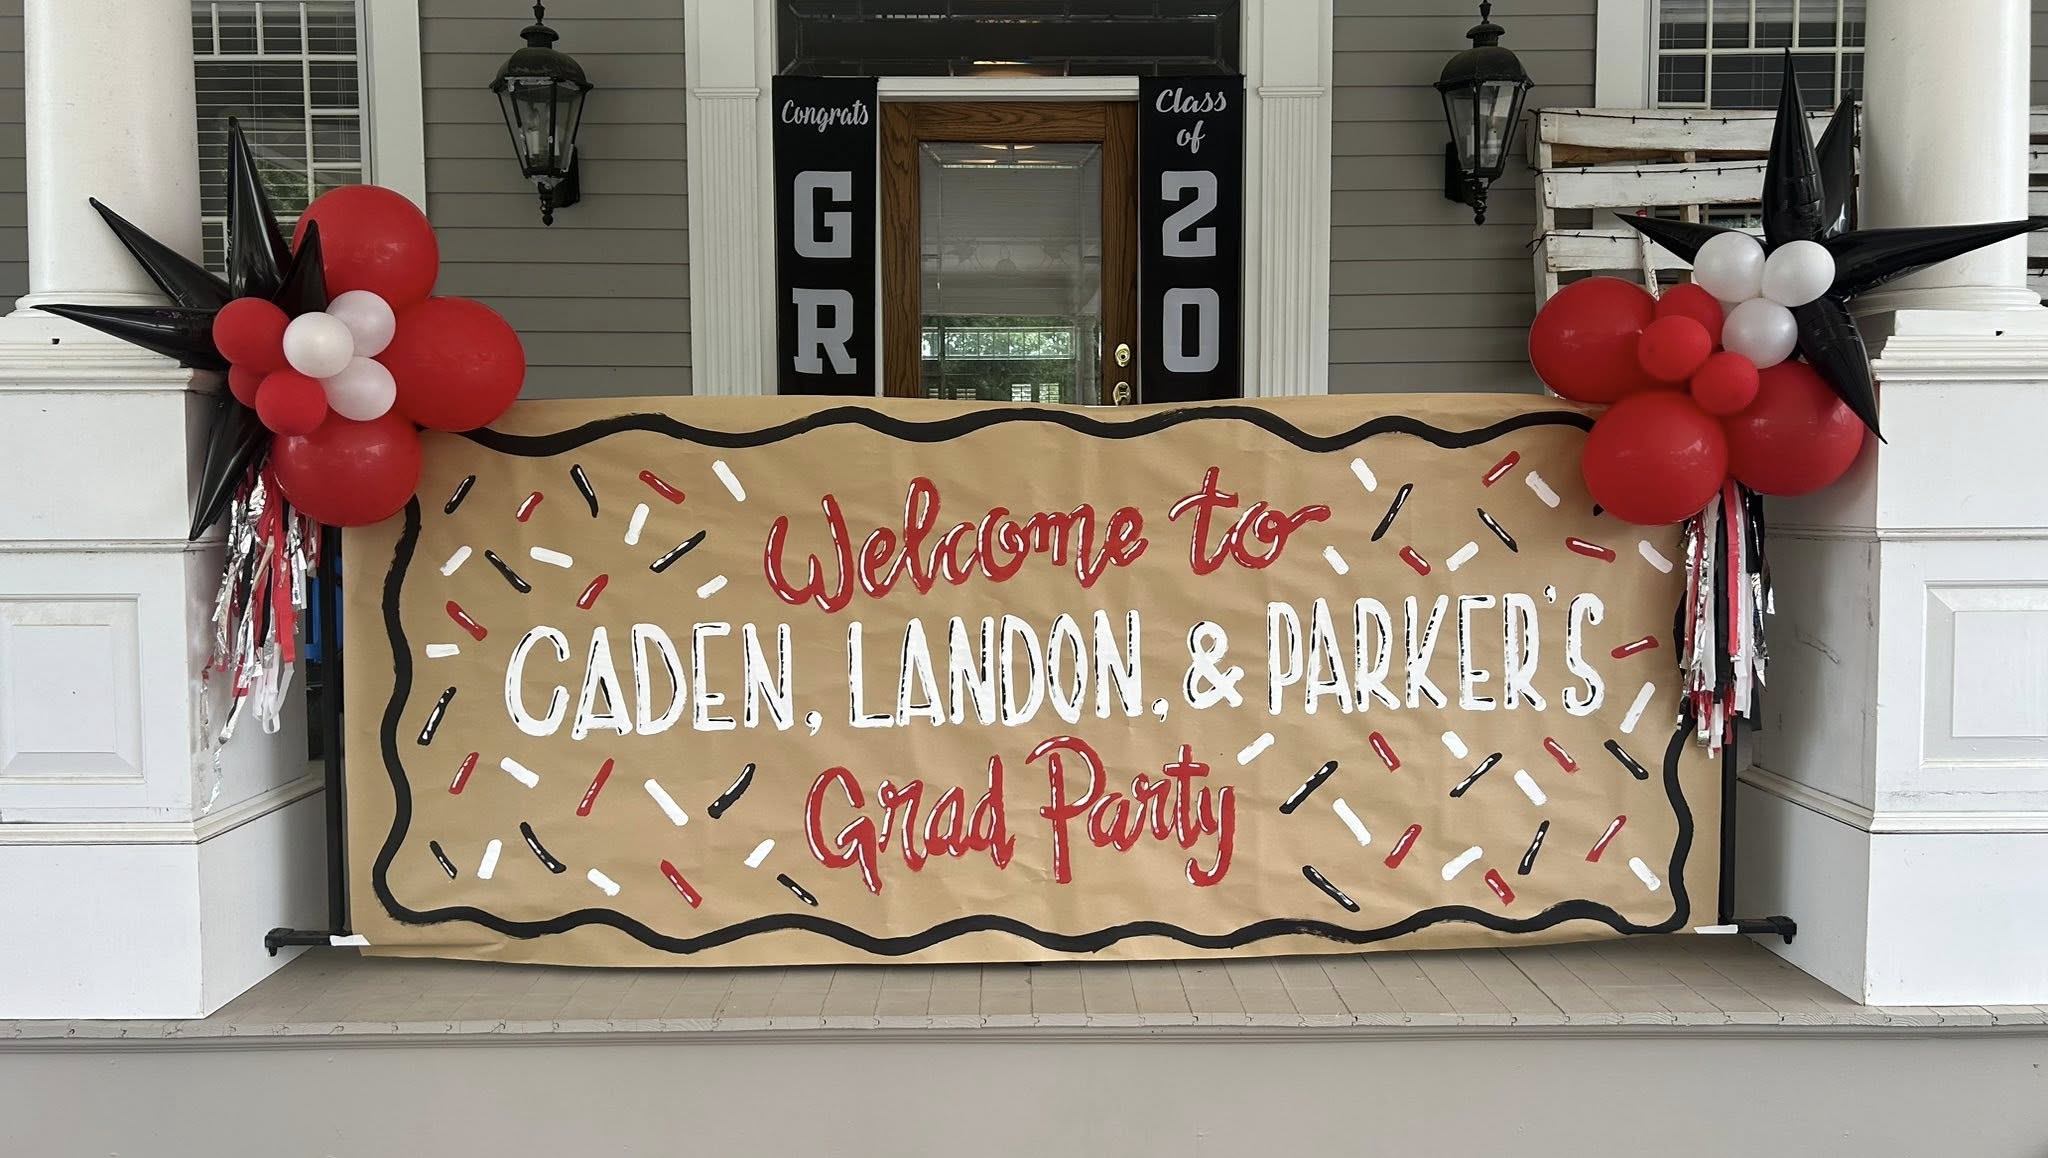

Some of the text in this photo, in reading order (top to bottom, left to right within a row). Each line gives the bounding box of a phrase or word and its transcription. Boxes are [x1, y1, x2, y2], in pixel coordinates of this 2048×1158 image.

[781, 99, 869, 133] Congrats
[1155, 87, 1228, 114] Class
[1176, 119, 1206, 154] of
[763, 466, 1330, 613] Welcome to
[505, 584, 1605, 741] CADEN, LANDON, & PARKER'S
[804, 735, 1236, 896] Grad Party
